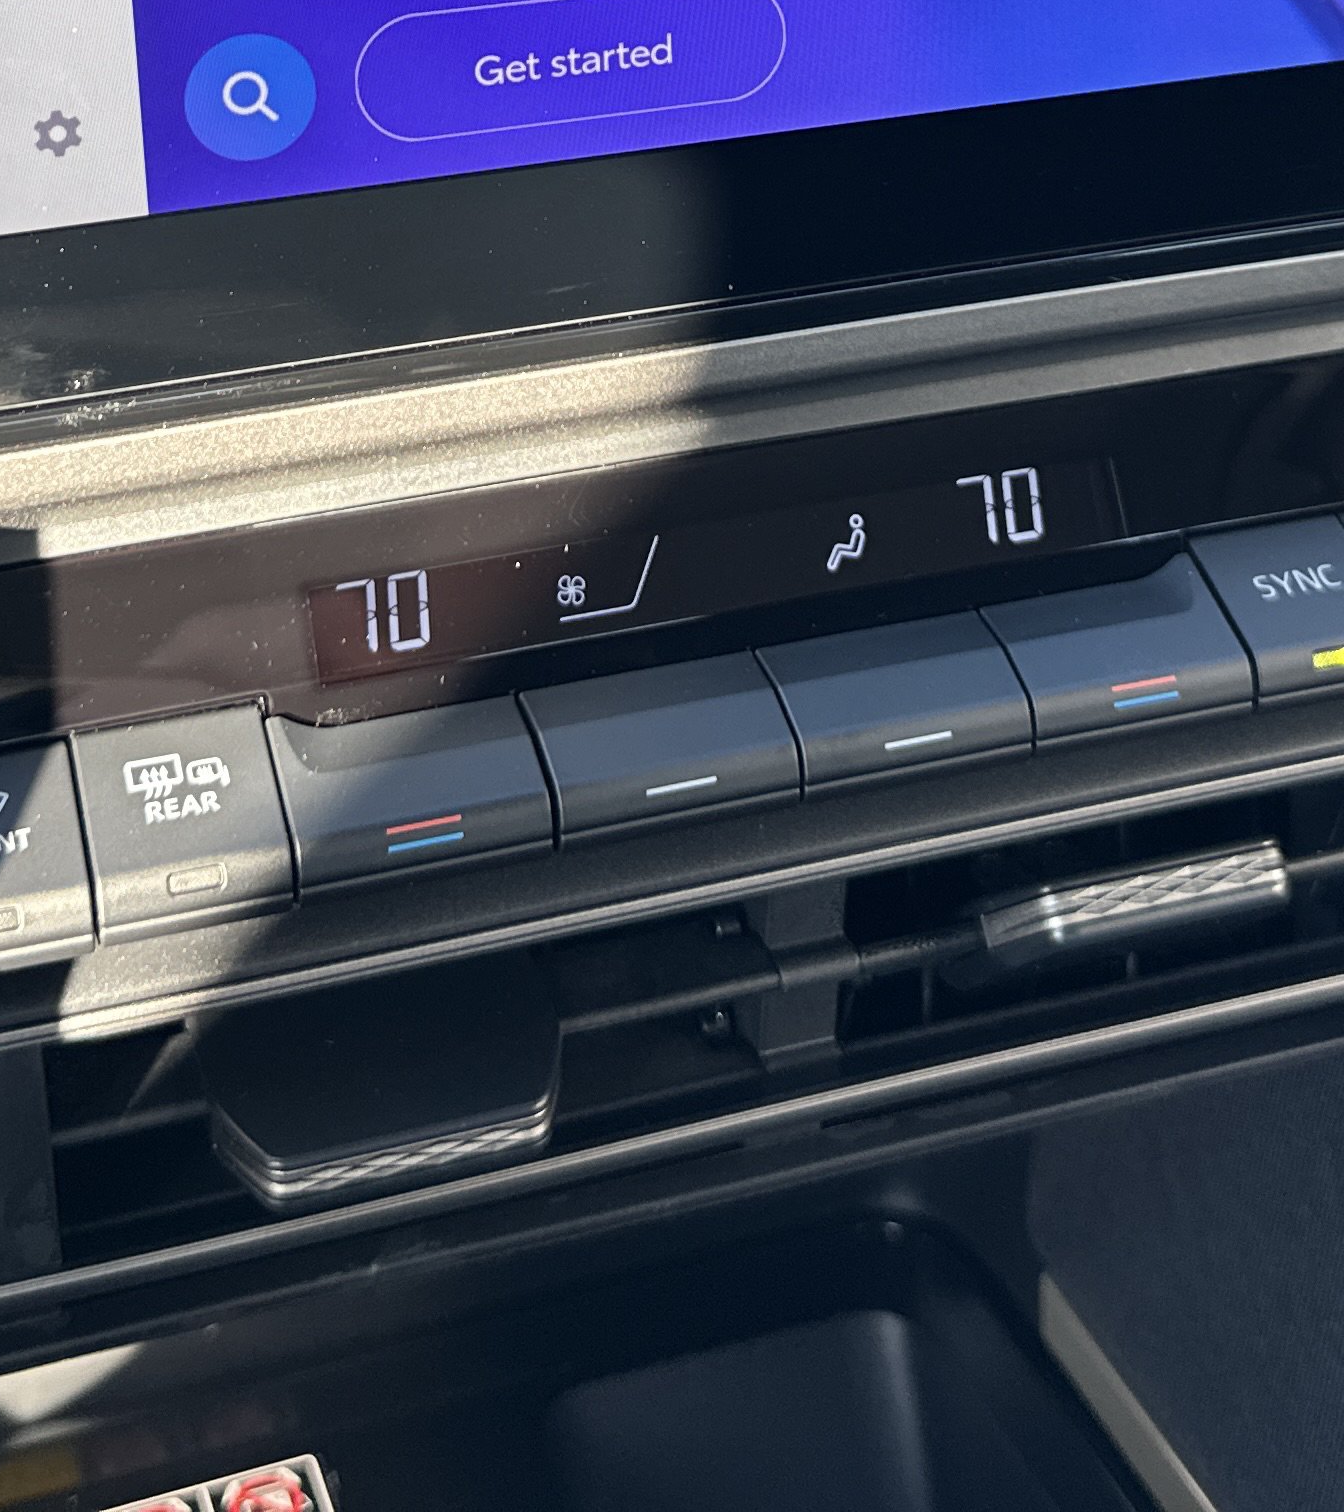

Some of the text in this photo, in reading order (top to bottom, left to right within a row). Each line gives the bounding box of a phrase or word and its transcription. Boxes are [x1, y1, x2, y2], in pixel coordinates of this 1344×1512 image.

[474, 34, 674, 88] Get started
[956, 466, 1045, 545] 70
[1252, 562, 1344, 601] SYNC
[334, 569, 431, 653] 70
[144, 791, 221, 825] REAR
